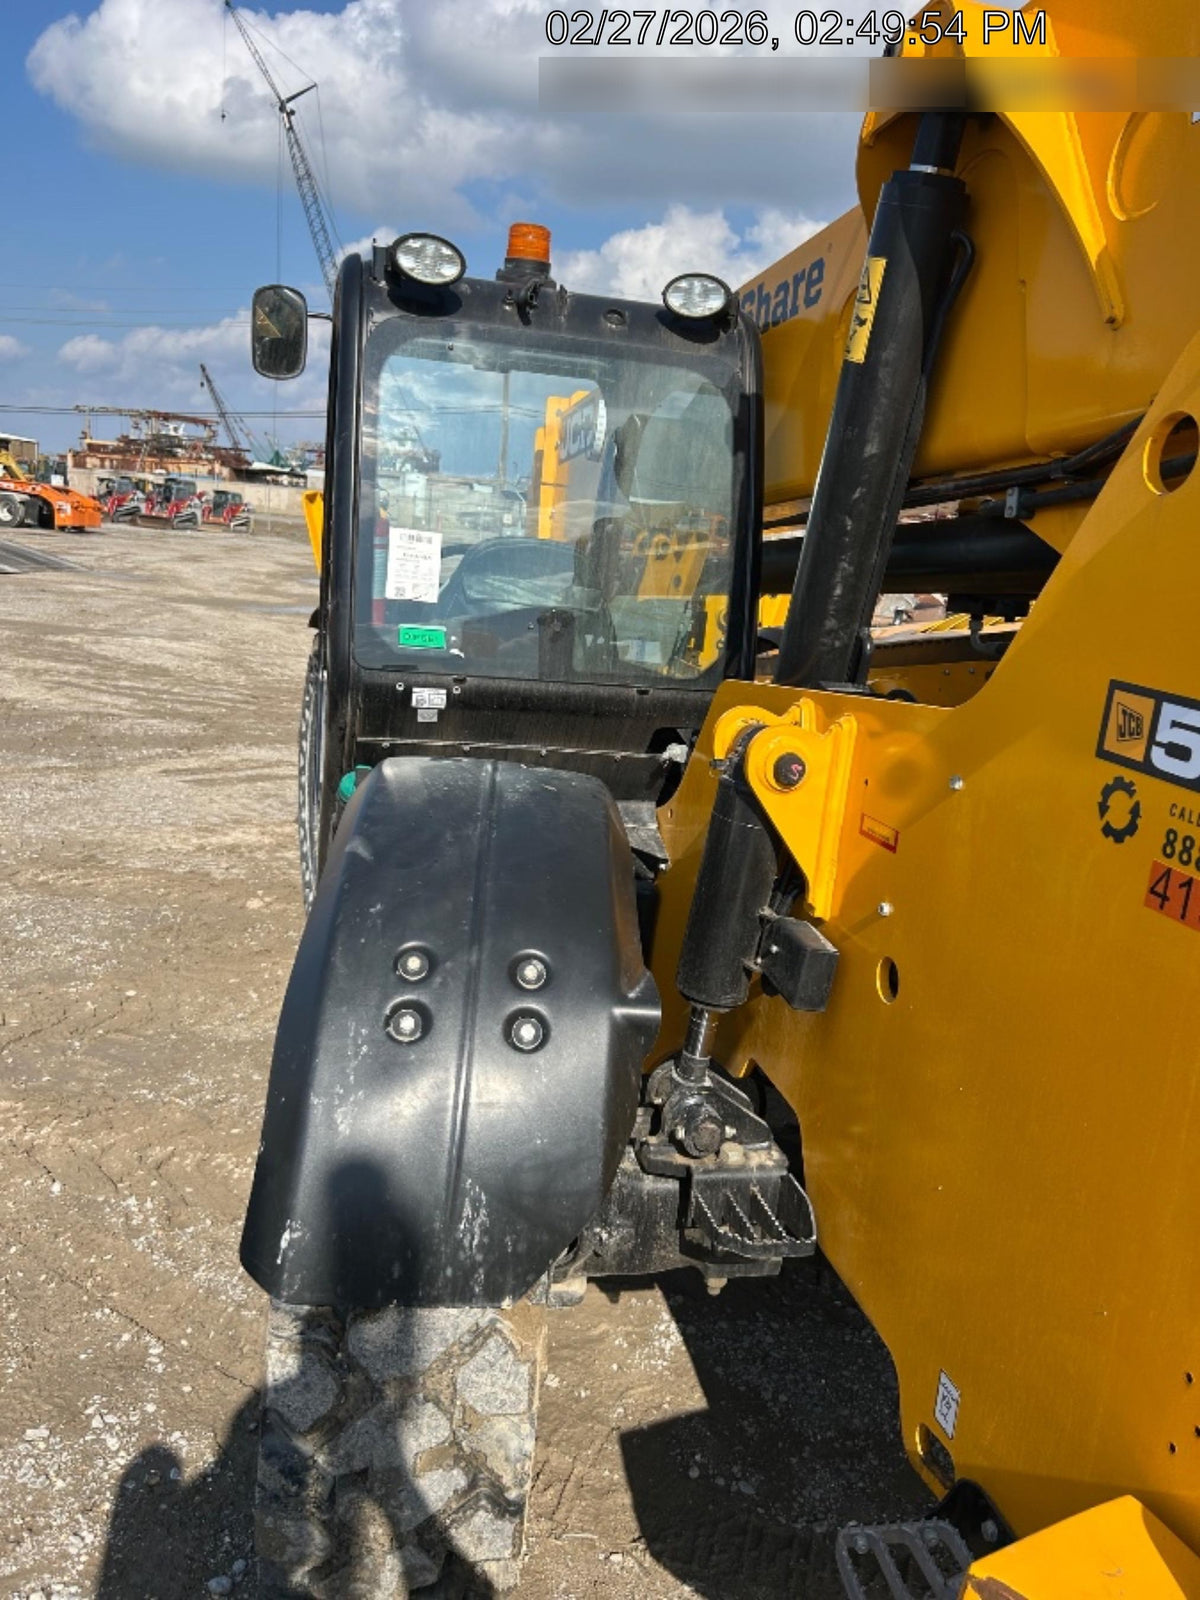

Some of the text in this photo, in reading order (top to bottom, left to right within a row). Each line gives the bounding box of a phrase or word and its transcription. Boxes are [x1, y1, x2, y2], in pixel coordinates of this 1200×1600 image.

[1118, 707, 1143, 738] JCB
[1162, 827, 1200, 873] 88
[1149, 867, 1200, 921] 41
